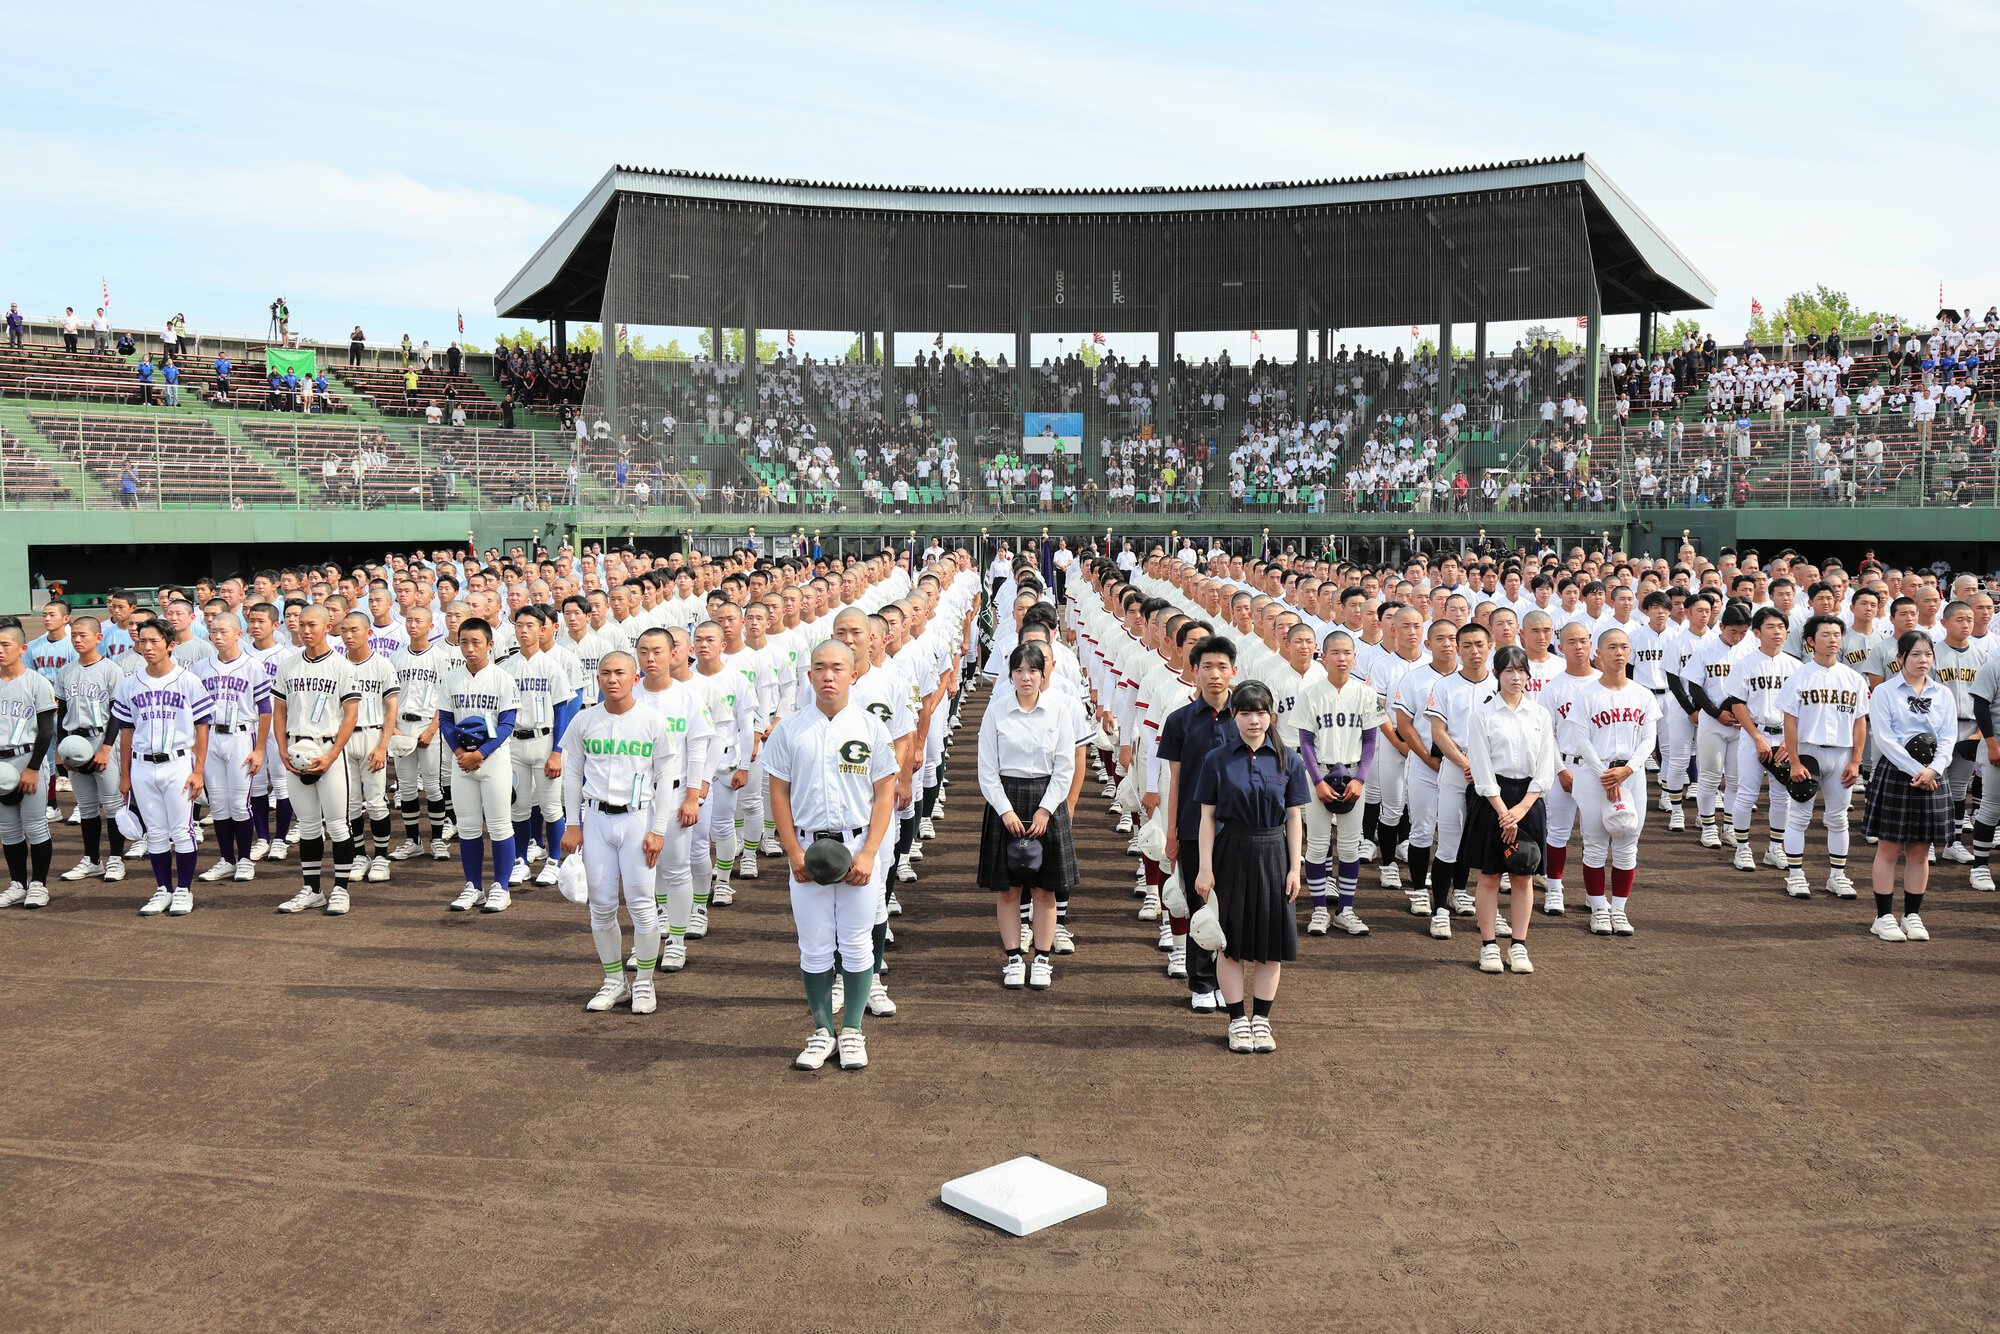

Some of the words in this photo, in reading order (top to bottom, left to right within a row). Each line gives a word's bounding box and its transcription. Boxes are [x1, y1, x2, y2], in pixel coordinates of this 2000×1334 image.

[131, 690, 186, 710] TOTTORI
[1801, 689, 1858, 706] YONAGO
[583, 739, 653, 758] YONAGO
